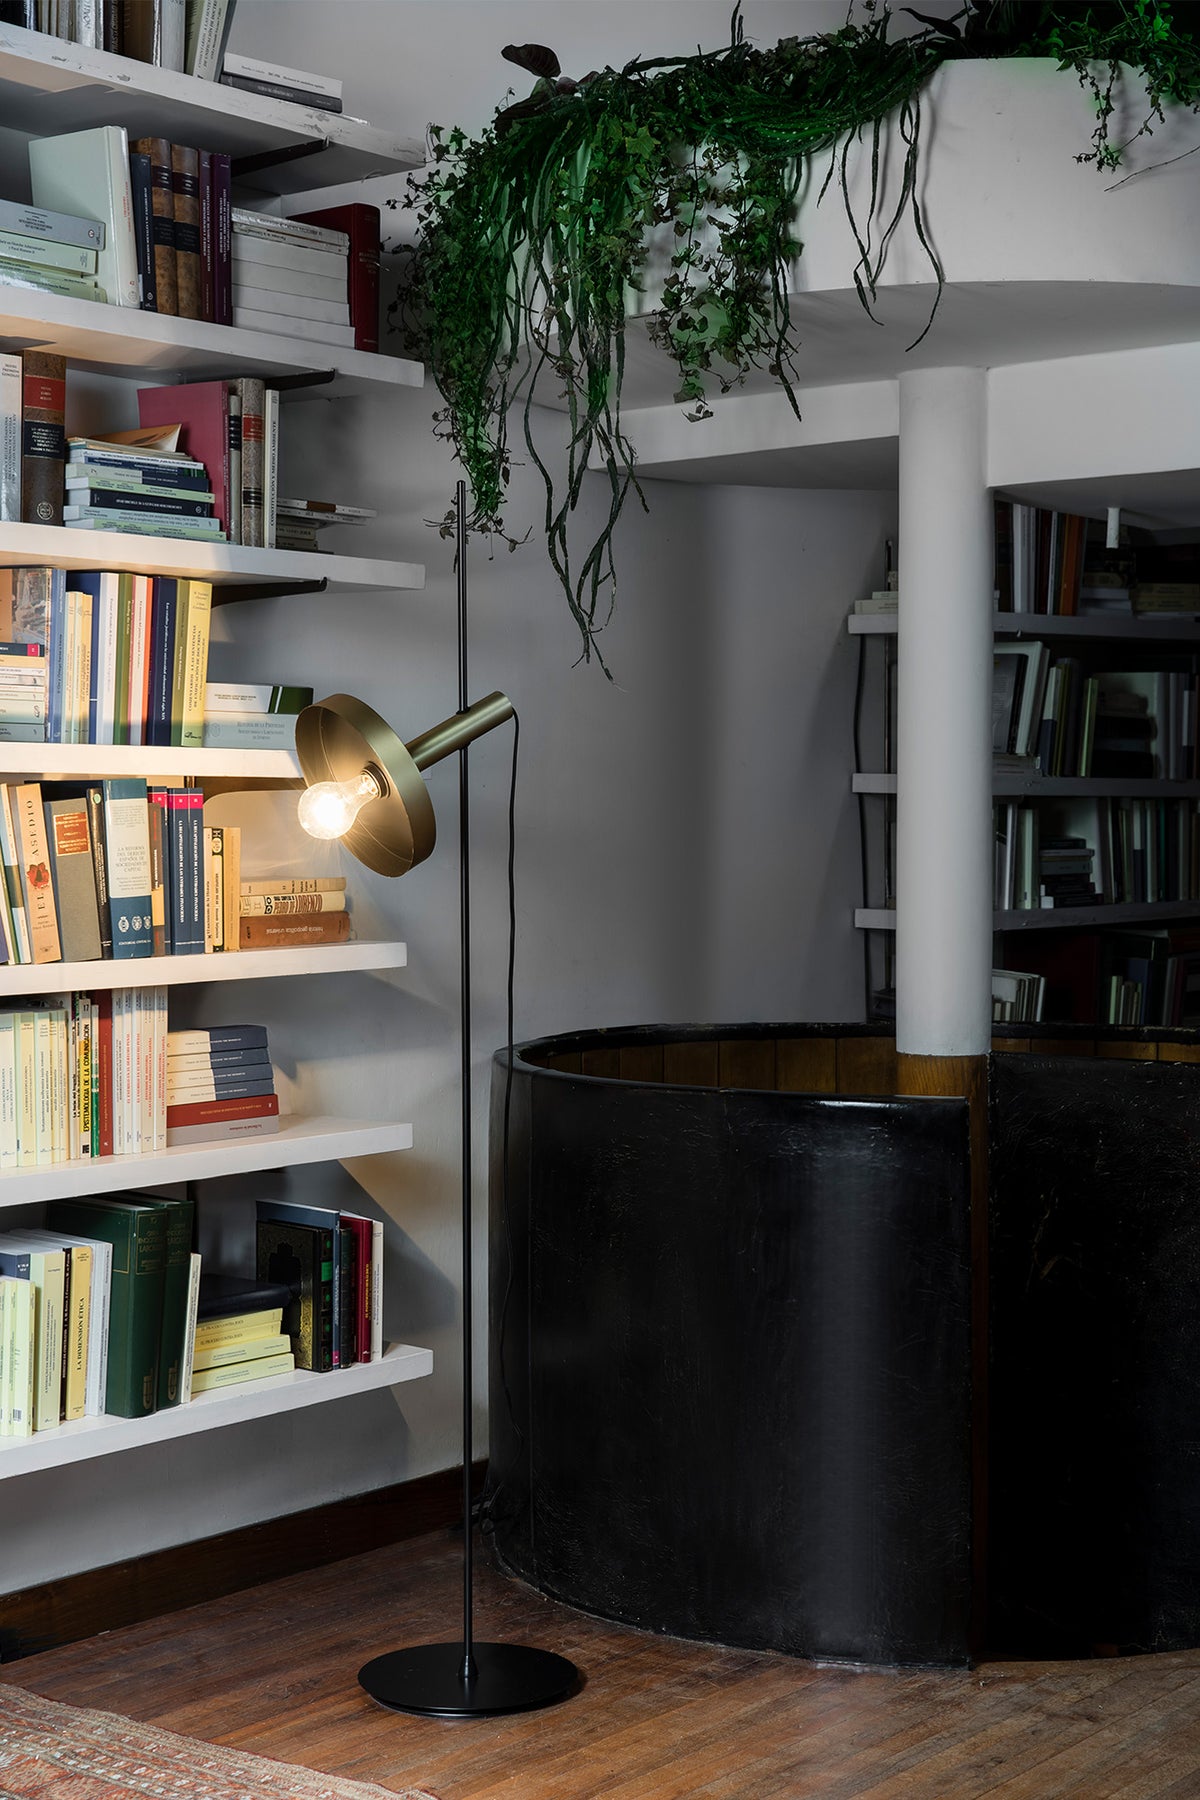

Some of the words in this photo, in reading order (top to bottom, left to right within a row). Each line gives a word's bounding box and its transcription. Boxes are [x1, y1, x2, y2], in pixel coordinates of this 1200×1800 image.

[26, 799, 40, 857] ASEDIO
[37, 892, 46, 910] EL
[295, 894, 323, 913] LORENZO
[77, 1298, 85, 1319] ÉTICA
[76, 1320, 84, 1360] DIMENSIÓN
